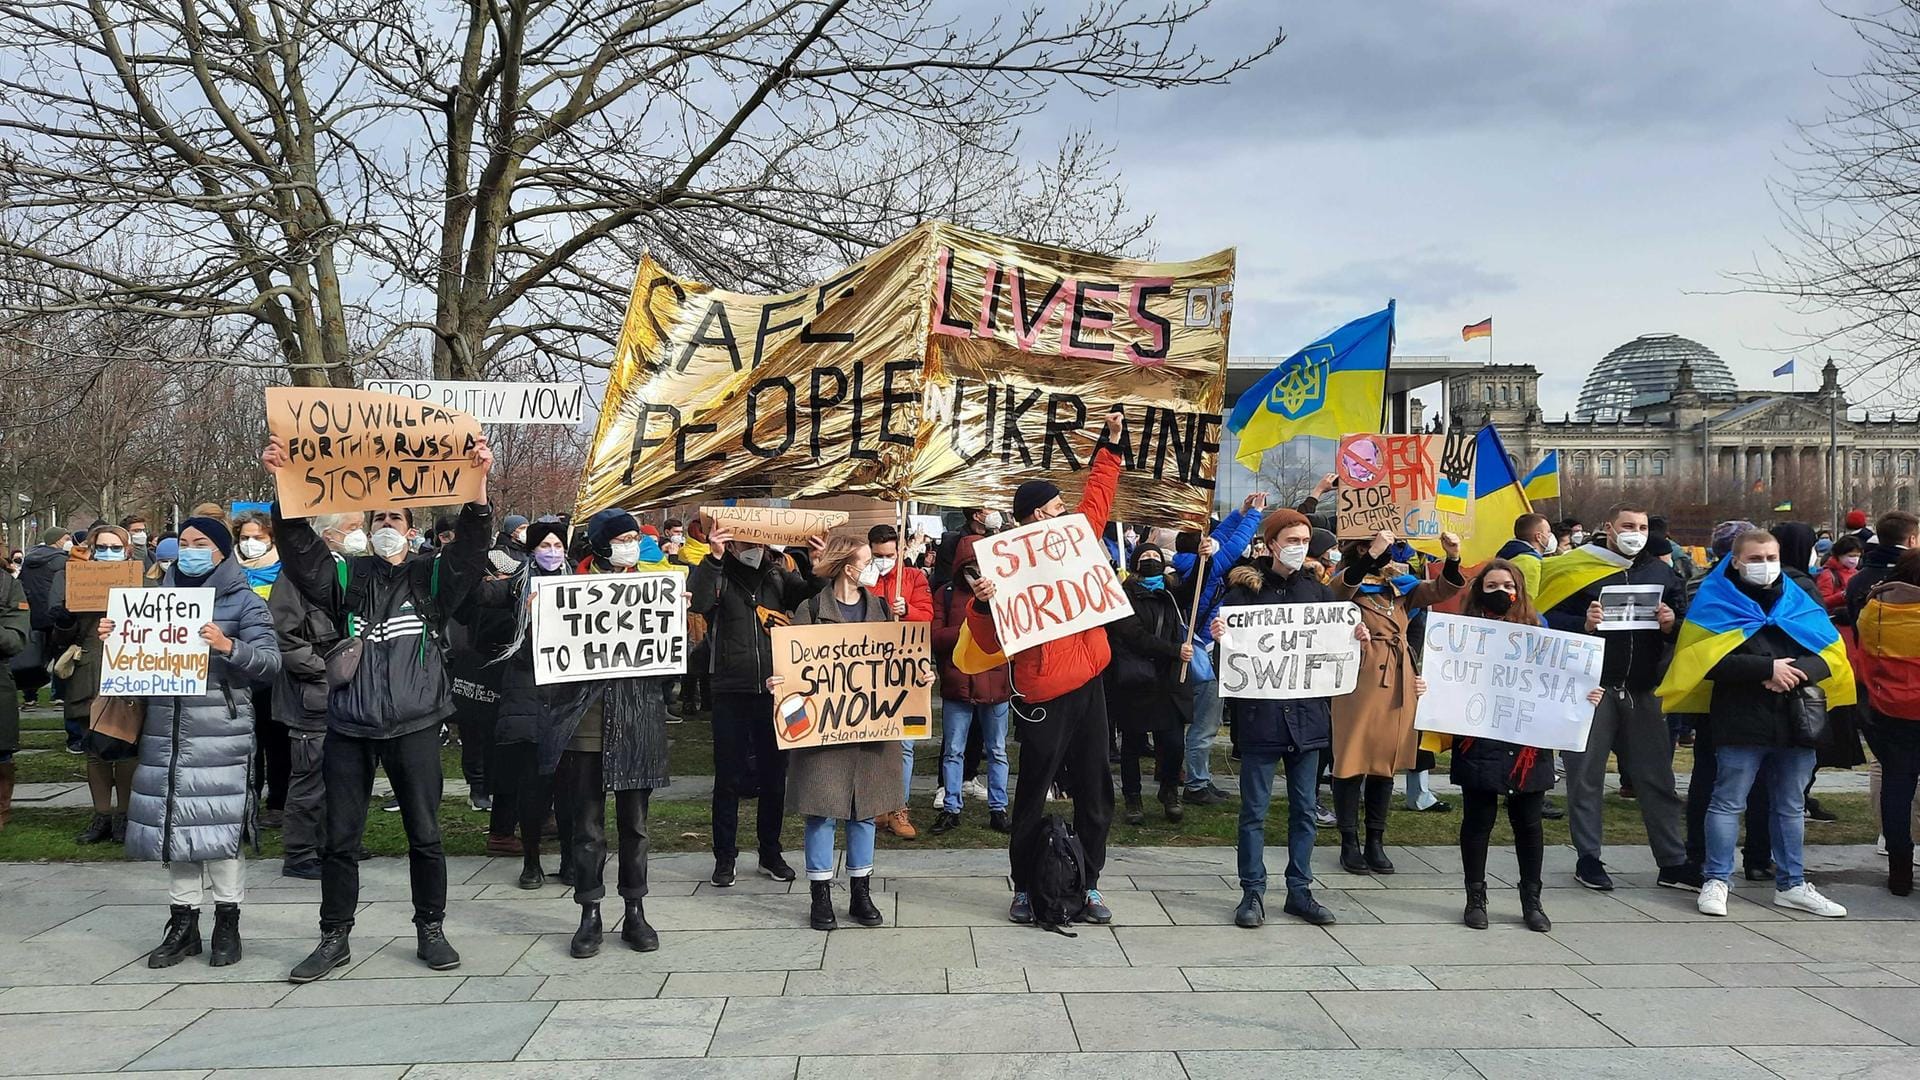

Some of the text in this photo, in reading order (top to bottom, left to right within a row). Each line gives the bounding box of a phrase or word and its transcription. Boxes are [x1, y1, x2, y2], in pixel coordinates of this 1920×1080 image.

[932, 245, 1174, 367] LIVES
[287, 399, 460, 435] YOU WILL PAY
[519, 385, 582, 421] NOW!
[622, 359, 924, 486] PEOPLE
[951, 378, 1223, 490] UKRAINE
[289, 436, 334, 464] FOR
[1386, 435, 1434, 467] FCK
[304, 464, 381, 509] STOP
[1341, 485, 1391, 512] STOP
[1388, 465, 1436, 503] PTN
[762, 507, 796, 526] TO
[1340, 505, 1400, 530] DICTATOR-
[992, 524, 1085, 579] STOP
[123, 592, 200, 623] Waffen
[556, 577, 676, 610] IT'S YOUR
[995, 564, 1126, 646] MORDOR
[120, 619, 188, 644] für die
[562, 608, 674, 637] TICKET
[1226, 606, 1357, 628] CENTRAL BANKS
[540, 636, 683, 673] TO HAGUE
[1257, 629, 1318, 654] CUT
[1426, 622, 1602, 675] CUT SWIFT
[105, 644, 208, 680] Verteidigung
[1223, 651, 1354, 693] SWIFT
[101, 674, 197, 694] #StopPutin
[1441, 659, 1578, 705] CUT RUSSIA
[818, 689, 909, 734] NOW
[1465, 692, 1536, 732] OFF
